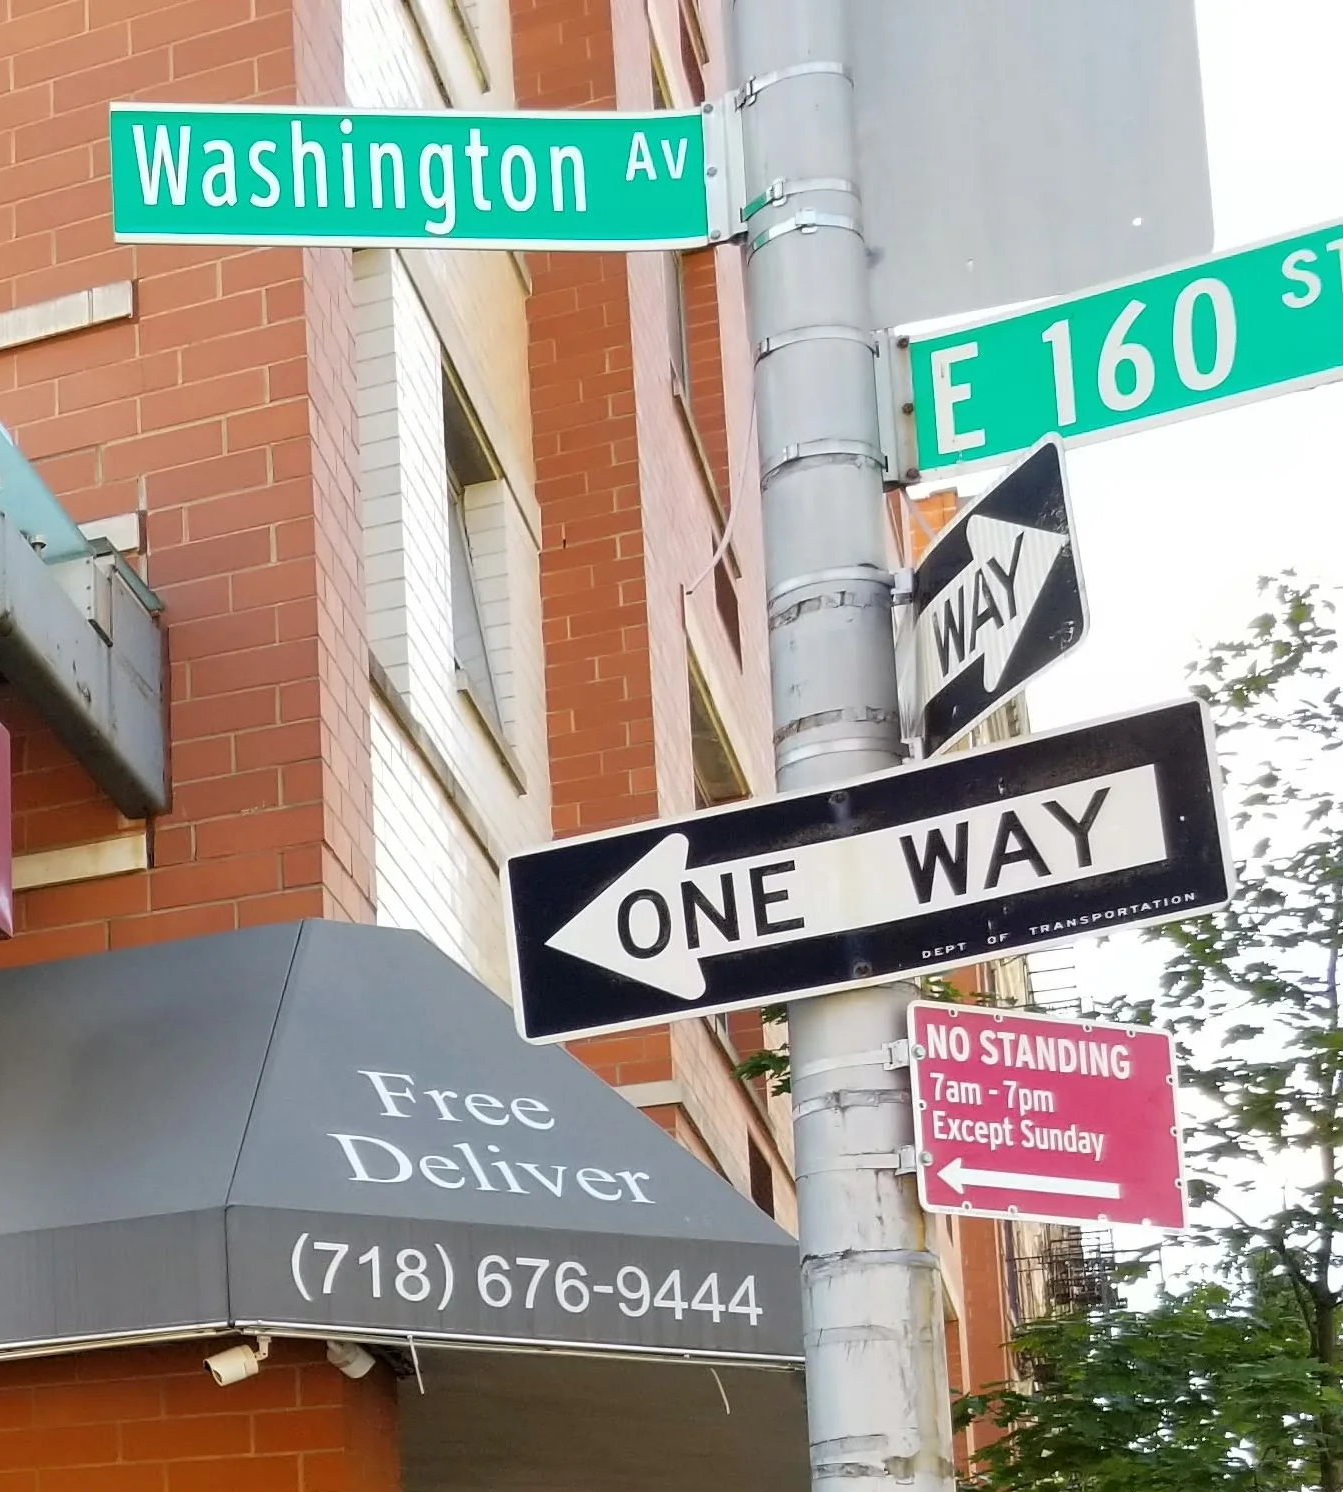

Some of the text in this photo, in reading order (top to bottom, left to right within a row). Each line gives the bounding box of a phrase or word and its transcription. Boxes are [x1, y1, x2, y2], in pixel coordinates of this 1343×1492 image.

[132, 119, 689, 235] Washington Av
[930, 341, 986, 455] E
[1041, 277, 1237, 427] 160
[934, 532, 1024, 676] WAY
[616, 786, 1112, 959] ONE WAY
[921, 891, 1196, 959] DEPT OF TRANSPORTATION
[926, 1023, 1131, 1079] NO STANDING
[357, 1070, 555, 1130] Free
[930, 1072, 981, 1105] 7am
[1003, 1080, 1054, 1116] 7pm
[327, 1133, 656, 1204] Deliver
[932, 1110, 1104, 1161] Except Sunday
[291, 1232, 763, 1326] (718) 676-9444
